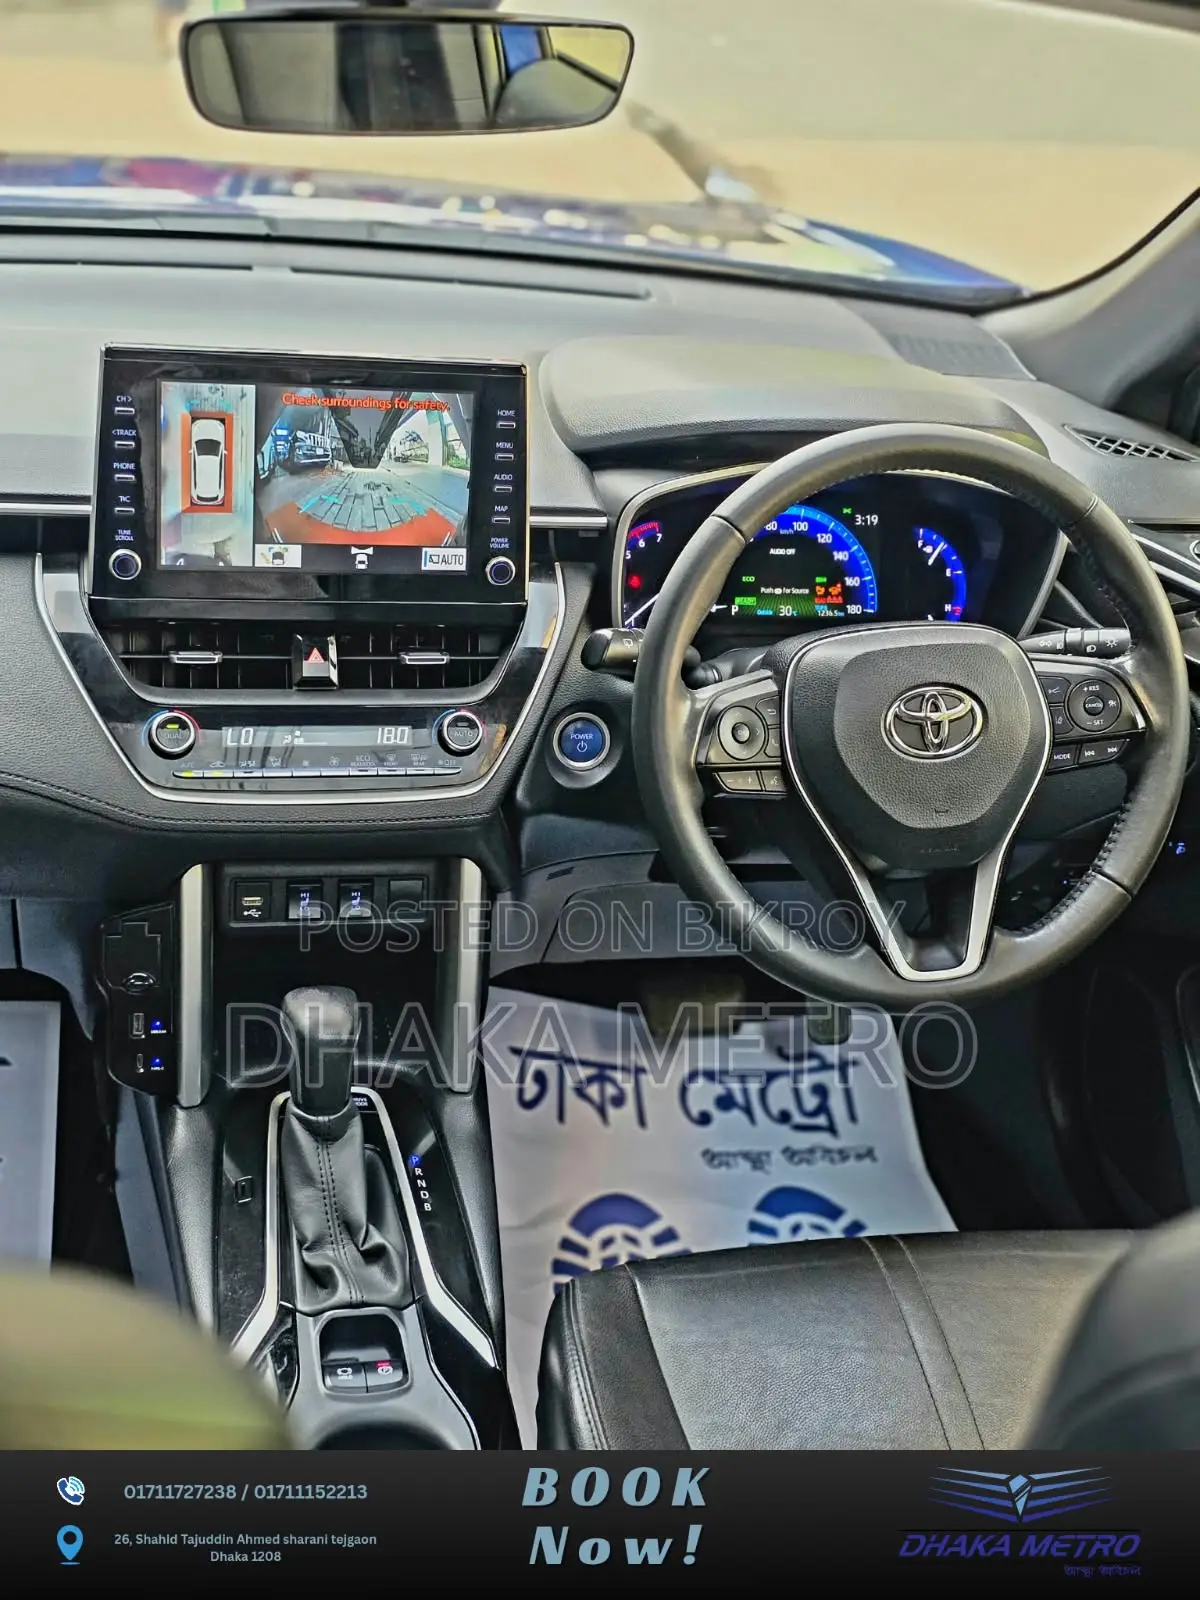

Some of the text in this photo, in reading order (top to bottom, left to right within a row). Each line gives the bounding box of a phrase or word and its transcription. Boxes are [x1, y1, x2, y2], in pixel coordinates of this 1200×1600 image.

[282, 392, 450, 412] Check surroundings for safety.
[854, 515, 879, 526] 3:19
[793, 521, 809, 532] 100
[656, 533, 662, 542] 7
[816, 533, 833, 543] 120
[638, 539, 646, 548] 6
[918, 540, 924, 548] F
[440, 554, 464, 566] AUTO
[625, 550, 632, 560] 5
[833, 551, 849, 561] 140
[945, 568, 952, 577] E
[844, 577, 860, 587] 160
[731, 605, 739, 616] P
[846, 605, 862, 615] 180
[944, 604, 952, 612] H
[226, 727, 254, 746] LO
[508, 1045, 860, 1138] ঢাকা মেট্রো
[411, 1155, 420, 1165] P
[414, 1167, 423, 1176] R
[417, 1179, 427, 1188] N
[420, 1190, 430, 1199] D
[424, 1202, 432, 1211] B
